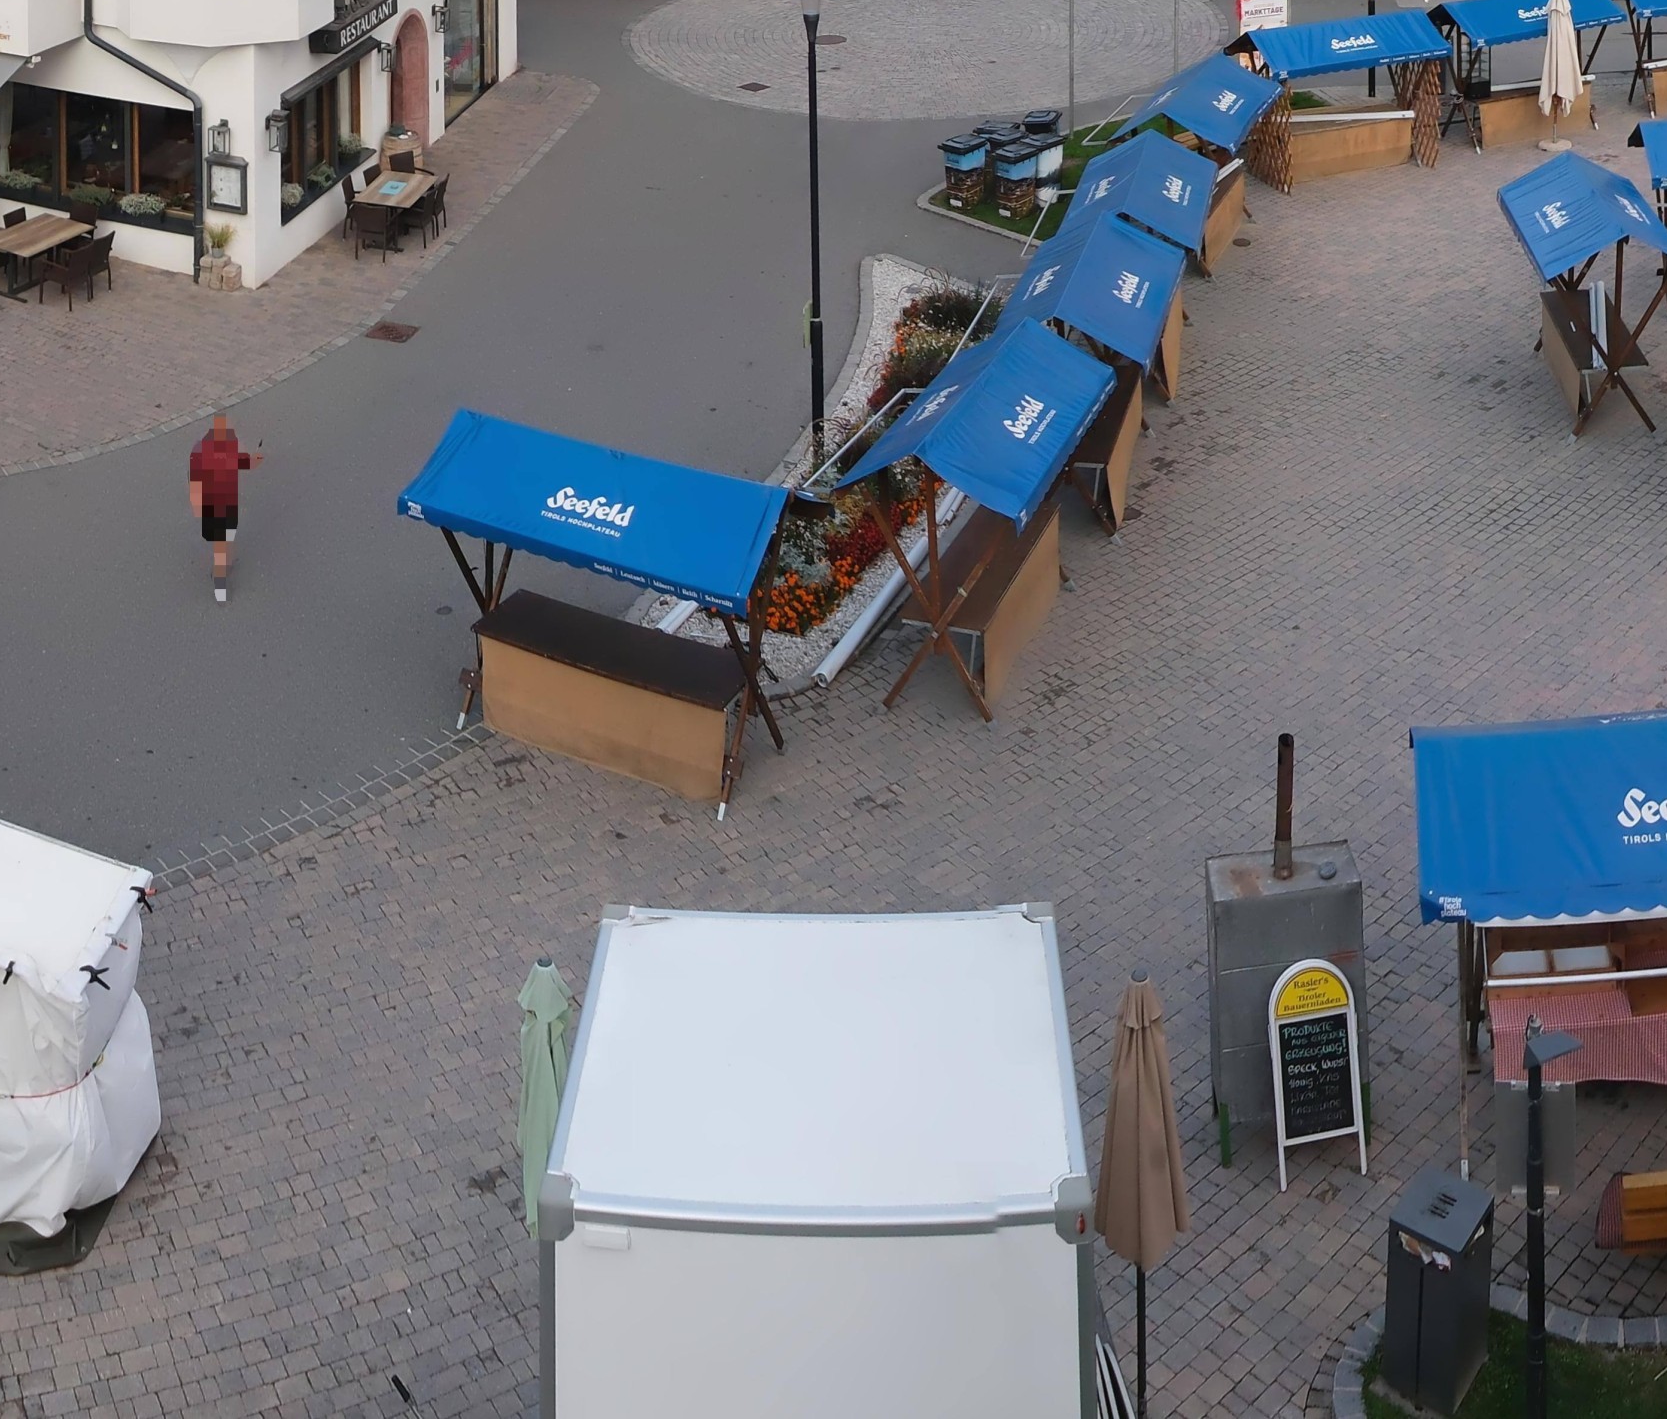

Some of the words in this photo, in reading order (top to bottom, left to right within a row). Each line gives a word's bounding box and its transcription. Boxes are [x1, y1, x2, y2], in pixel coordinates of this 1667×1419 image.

[1244, 6, 1284, 18] MARKTTAGE
[1330, 34, 1376, 51] Seefeld
[1002, 394, 1045, 441] Seefeld
[546, 486, 635, 528] Seefeld
[540, 509, 566, 523] TIROLS
[1622, 833, 1662, 845] TIROLS
[1283, 996, 1342, 1013] Bauernladen
[1296, 991, 1327, 1003] Tiroler
